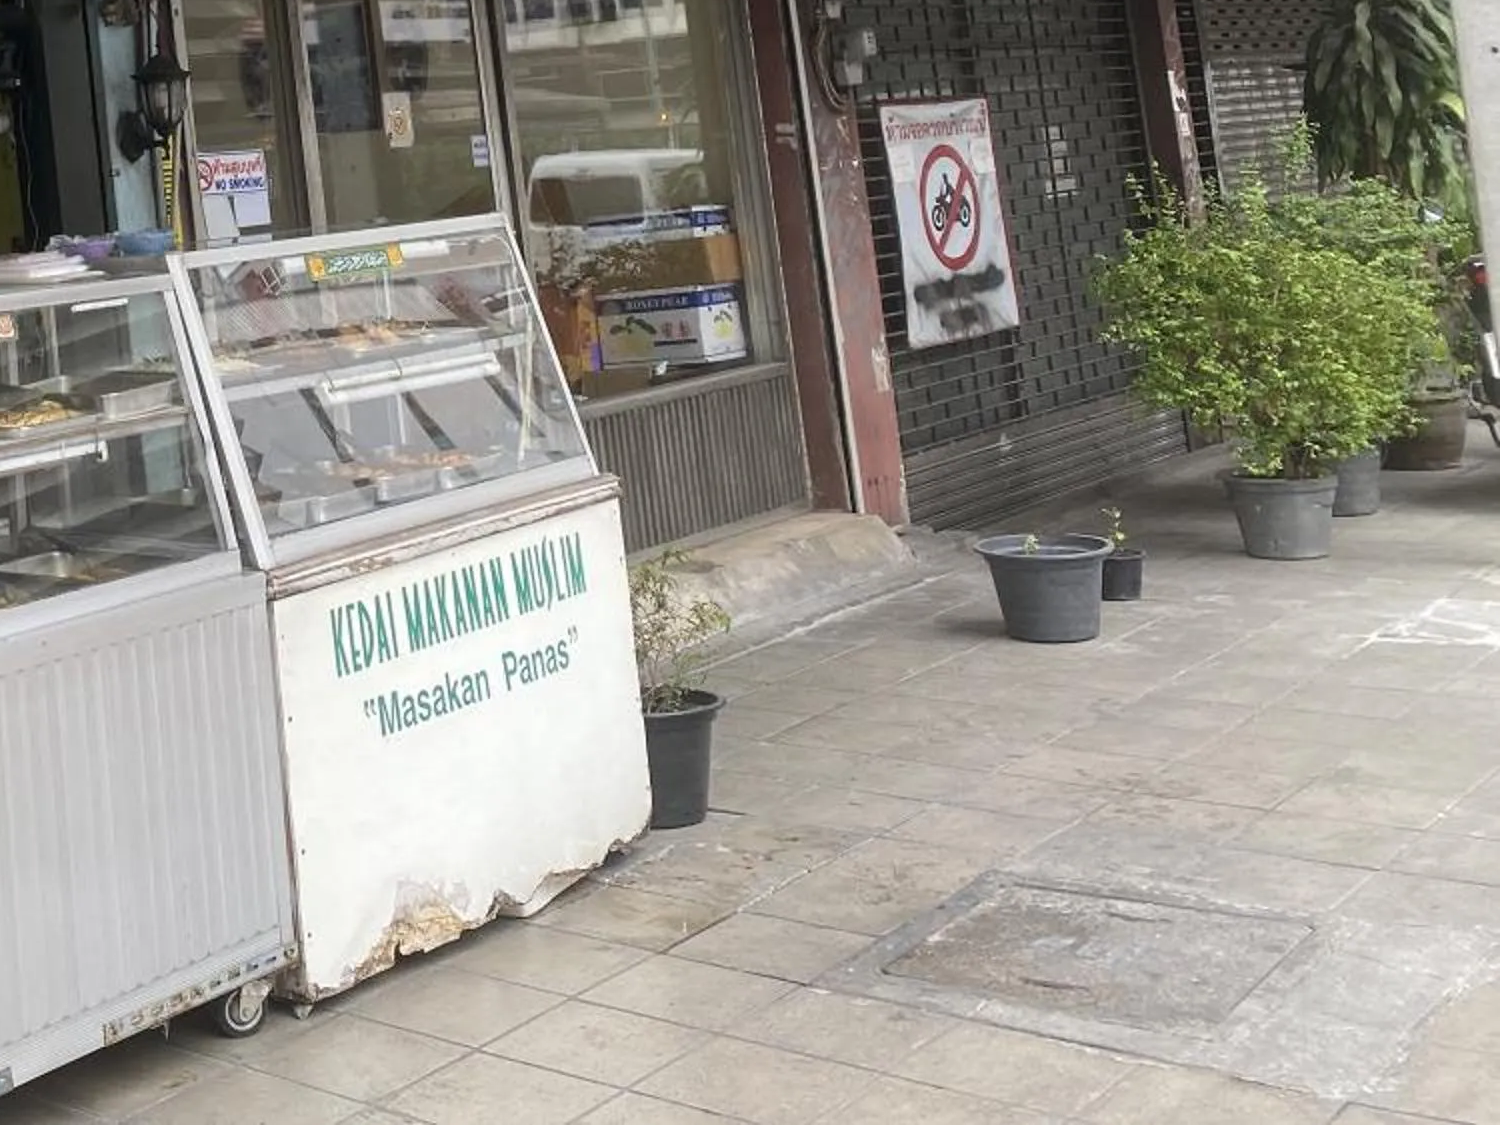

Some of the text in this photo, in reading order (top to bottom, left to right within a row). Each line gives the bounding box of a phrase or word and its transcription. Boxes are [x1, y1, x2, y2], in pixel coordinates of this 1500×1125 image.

[330, 532, 587, 677] KEDAI MAKANAN MUSLIM
